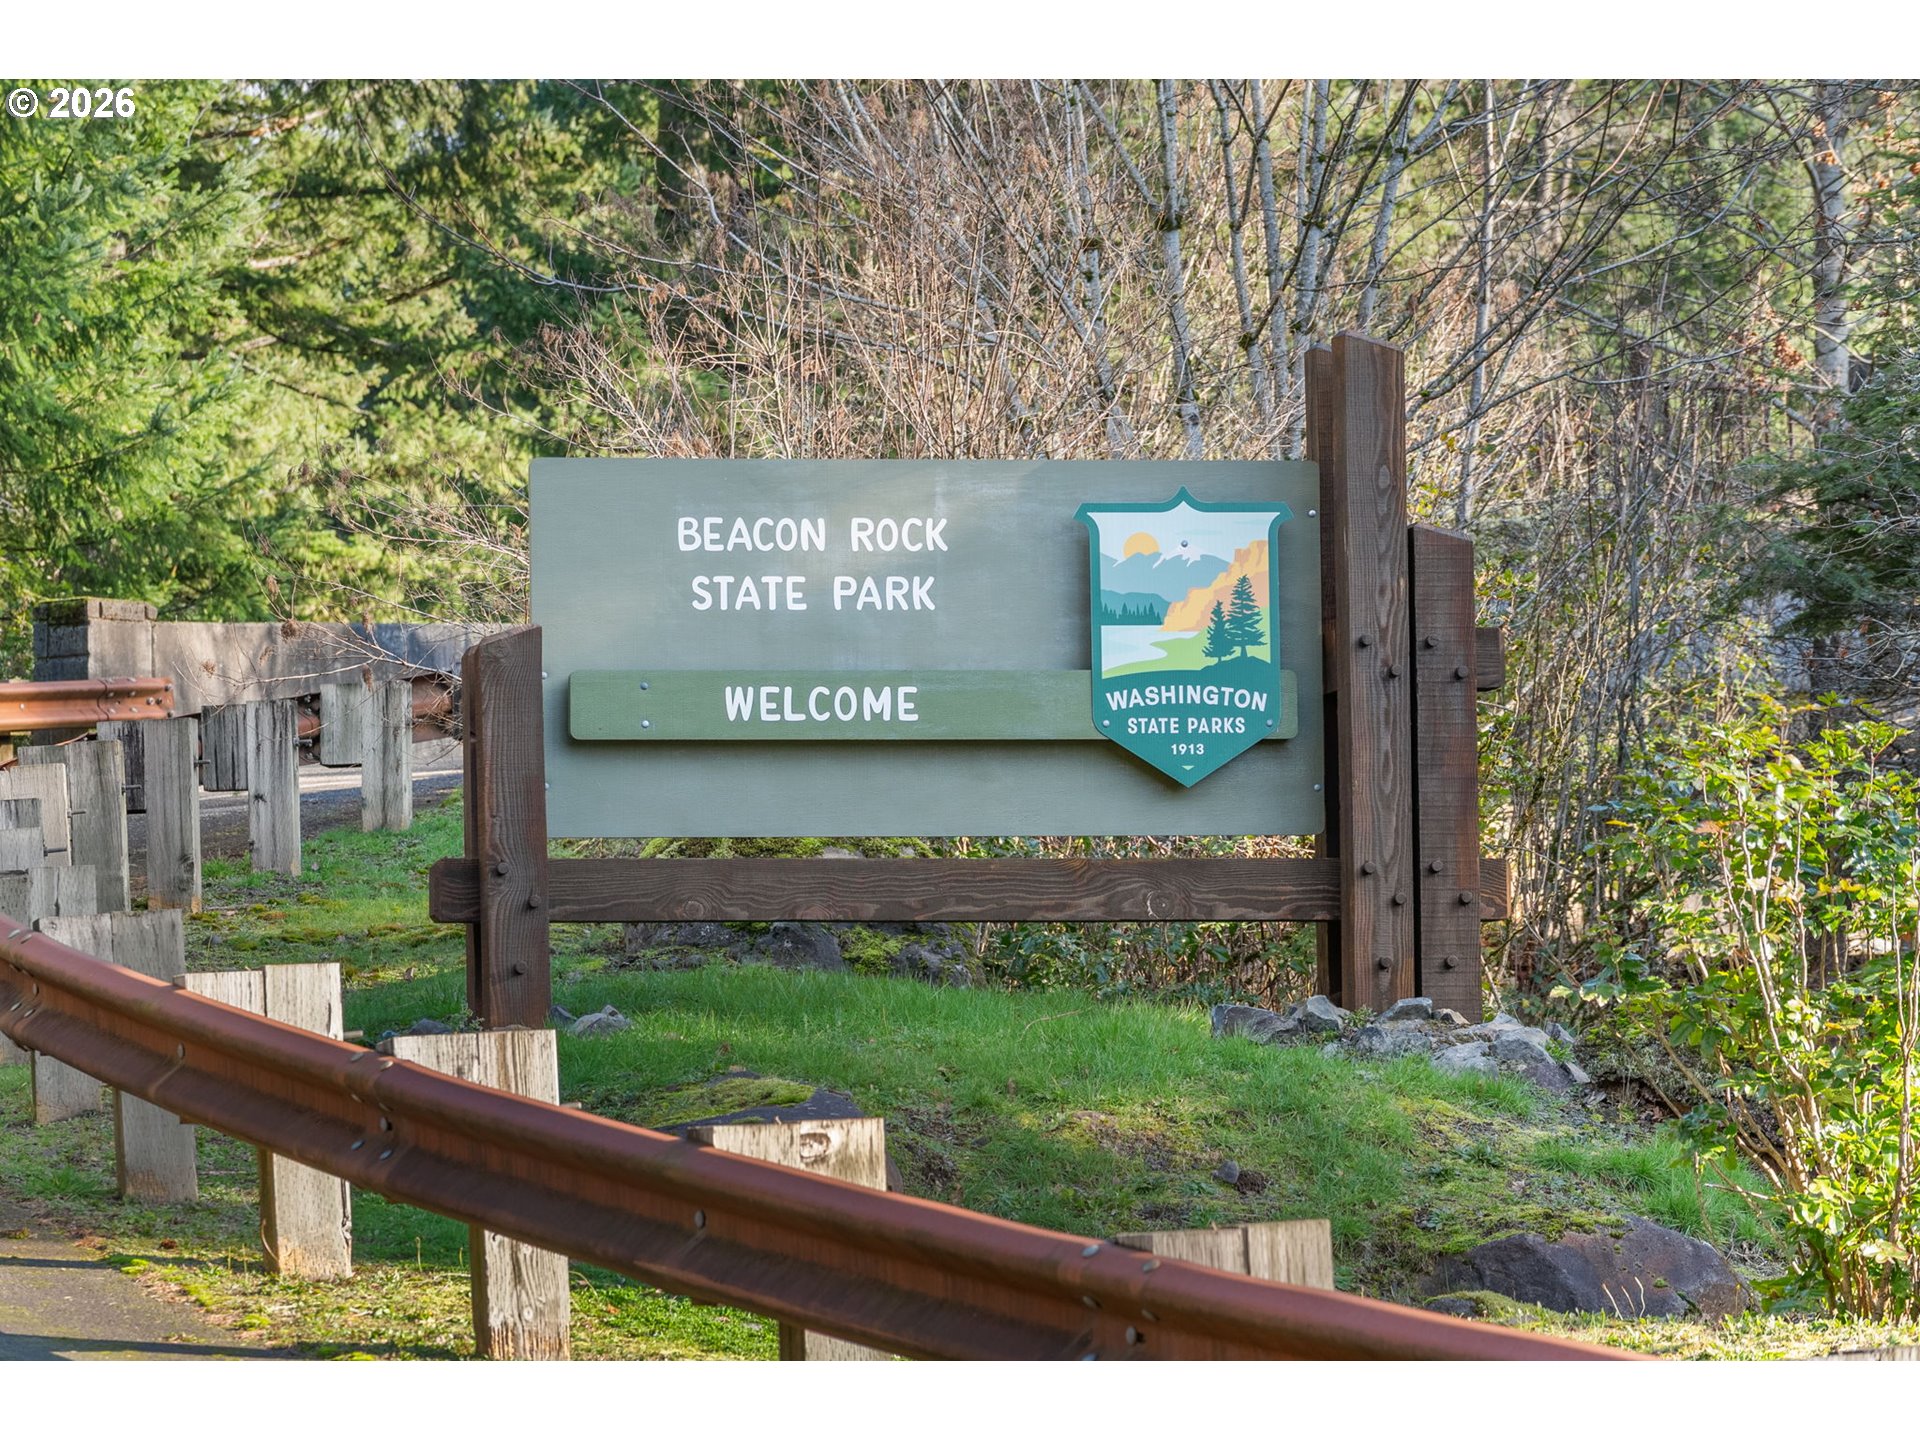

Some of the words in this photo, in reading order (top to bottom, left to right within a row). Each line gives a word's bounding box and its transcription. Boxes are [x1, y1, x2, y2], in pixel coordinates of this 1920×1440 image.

[677, 516, 826, 552] BEACON
[850, 516, 949, 553] ROCK
[691, 575, 808, 611] STATE
[833, 575, 936, 611] PARK
[725, 685, 919, 722] WELCOME
[1105, 685, 1267, 712] WASHINGTON
[1127, 717, 1179, 735] STATE
[1187, 716, 1246, 734] PARKS
[1171, 743, 1205, 755] 1913
